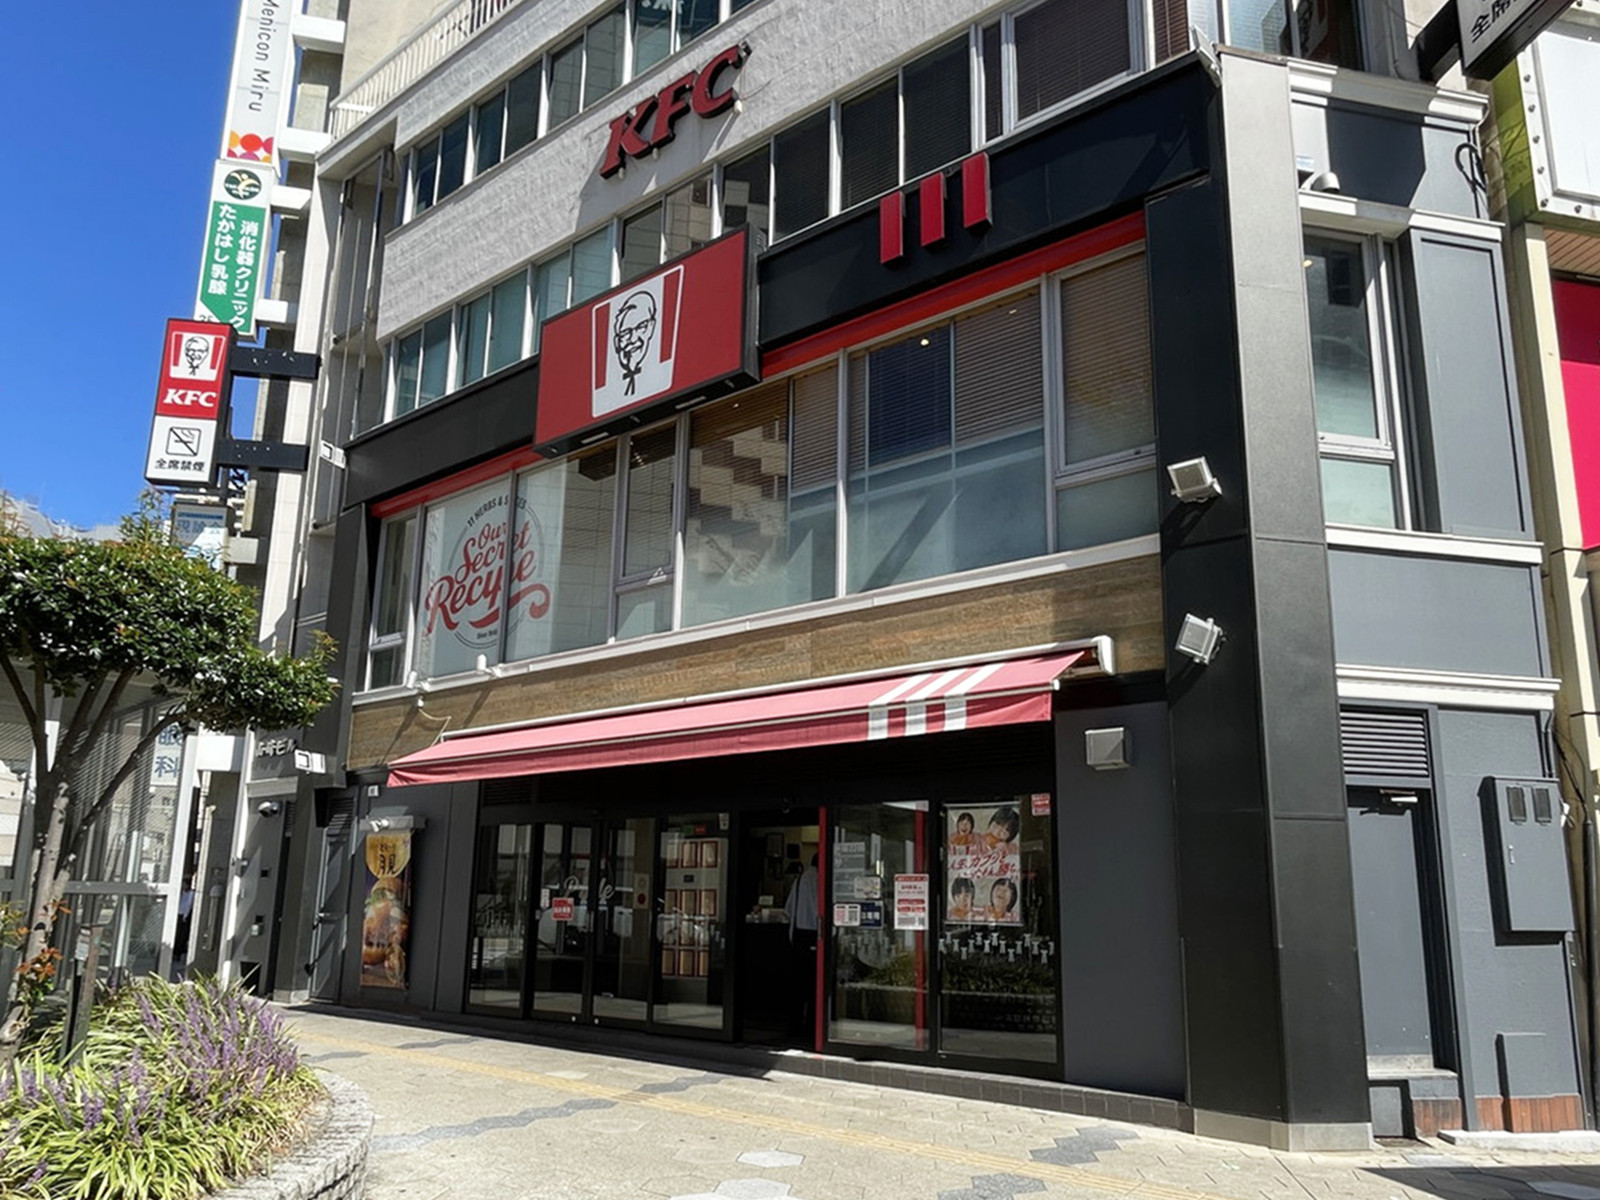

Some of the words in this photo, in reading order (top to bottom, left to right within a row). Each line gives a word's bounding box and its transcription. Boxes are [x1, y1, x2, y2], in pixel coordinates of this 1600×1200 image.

[1471, 0, 1517, 43] 全席
[248, 67, 271, 112] Miru
[600, 41, 752, 180] KFC
[207, 203, 237, 295] たかはし乳腺
[229, 219, 260, 328] 消化器クリニック
[163, 388, 217, 407] KFC
[154, 458, 205, 472] 全席禁煙
[155, 724, 183, 778] 眼科
